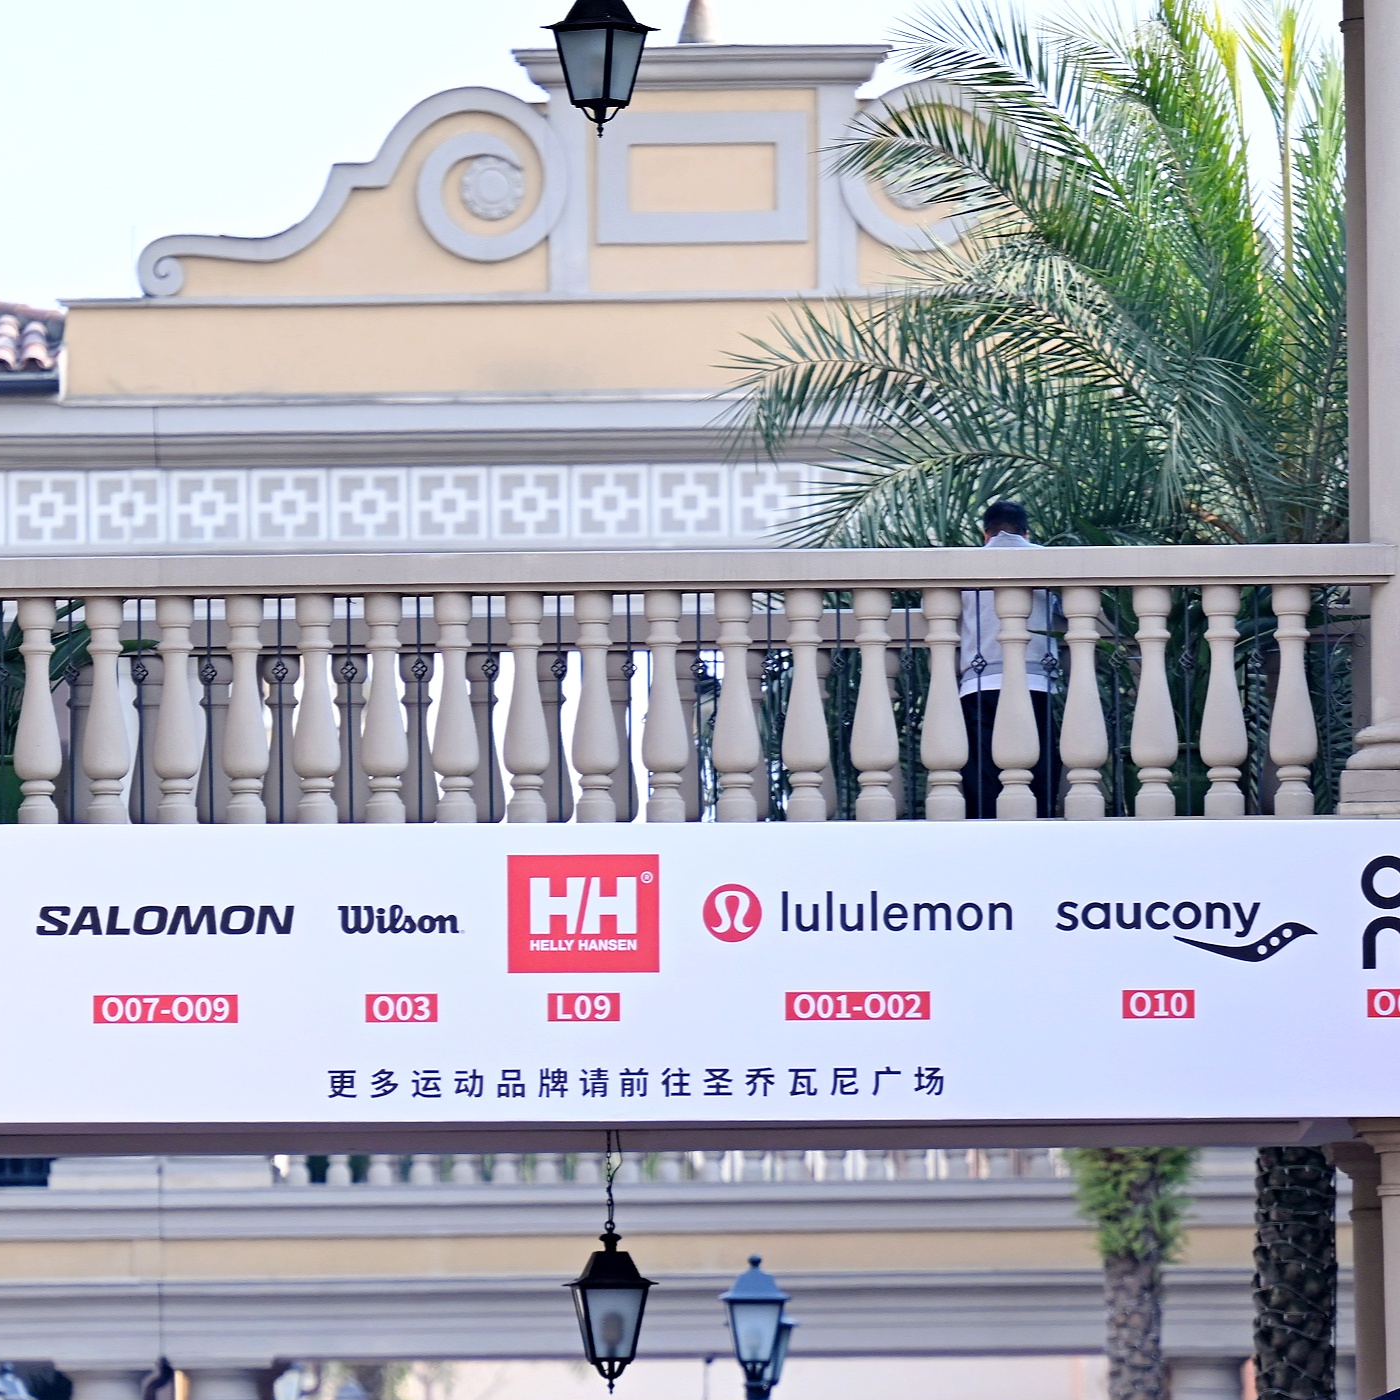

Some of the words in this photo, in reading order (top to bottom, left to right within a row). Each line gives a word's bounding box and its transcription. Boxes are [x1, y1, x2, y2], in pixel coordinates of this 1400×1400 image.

[36, 905, 295, 936] SALOMON
[337, 904, 460, 935] Wilson
[781, 890, 1013, 932] lululemon
[1056, 900, 1261, 938] saucony
[529, 939, 575, 952] HELLY
[578, 938, 638, 952] HANSEN
[556, 995, 612, 1021] L09
[327, 1066, 944, 1099] 更多运动品牌请前往圣乔瓦尼广场
